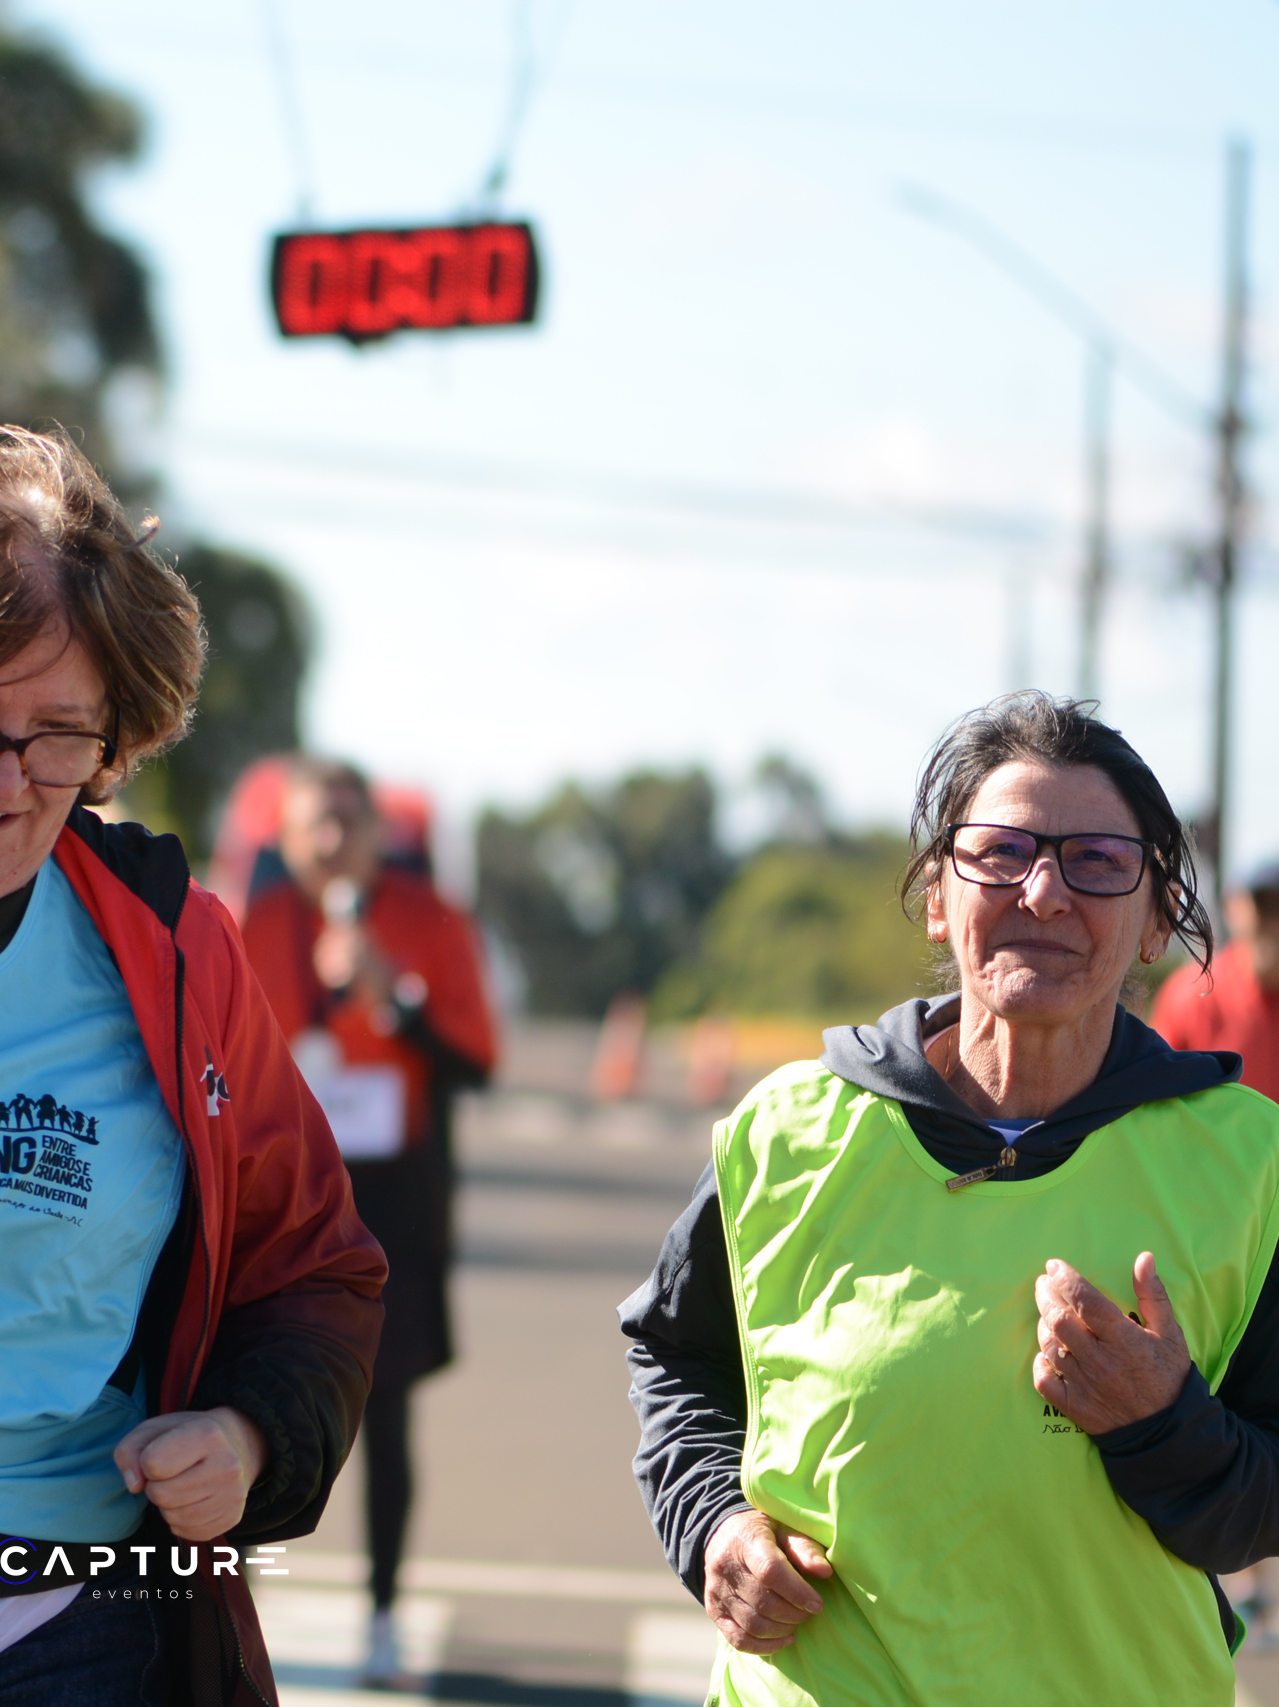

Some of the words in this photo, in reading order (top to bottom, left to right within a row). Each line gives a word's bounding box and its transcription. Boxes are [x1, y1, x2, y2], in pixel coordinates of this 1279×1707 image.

[278, 222, 529, 336] 00:00
[42, 1134, 77, 1157] ENTRE
[39, 1149, 82, 1174] AMIGOS
[82, 1161, 92, 1177] E
[33, 1183, 88, 1210] DIVERTIDA
[1043, 1404, 1051, 1417] A
